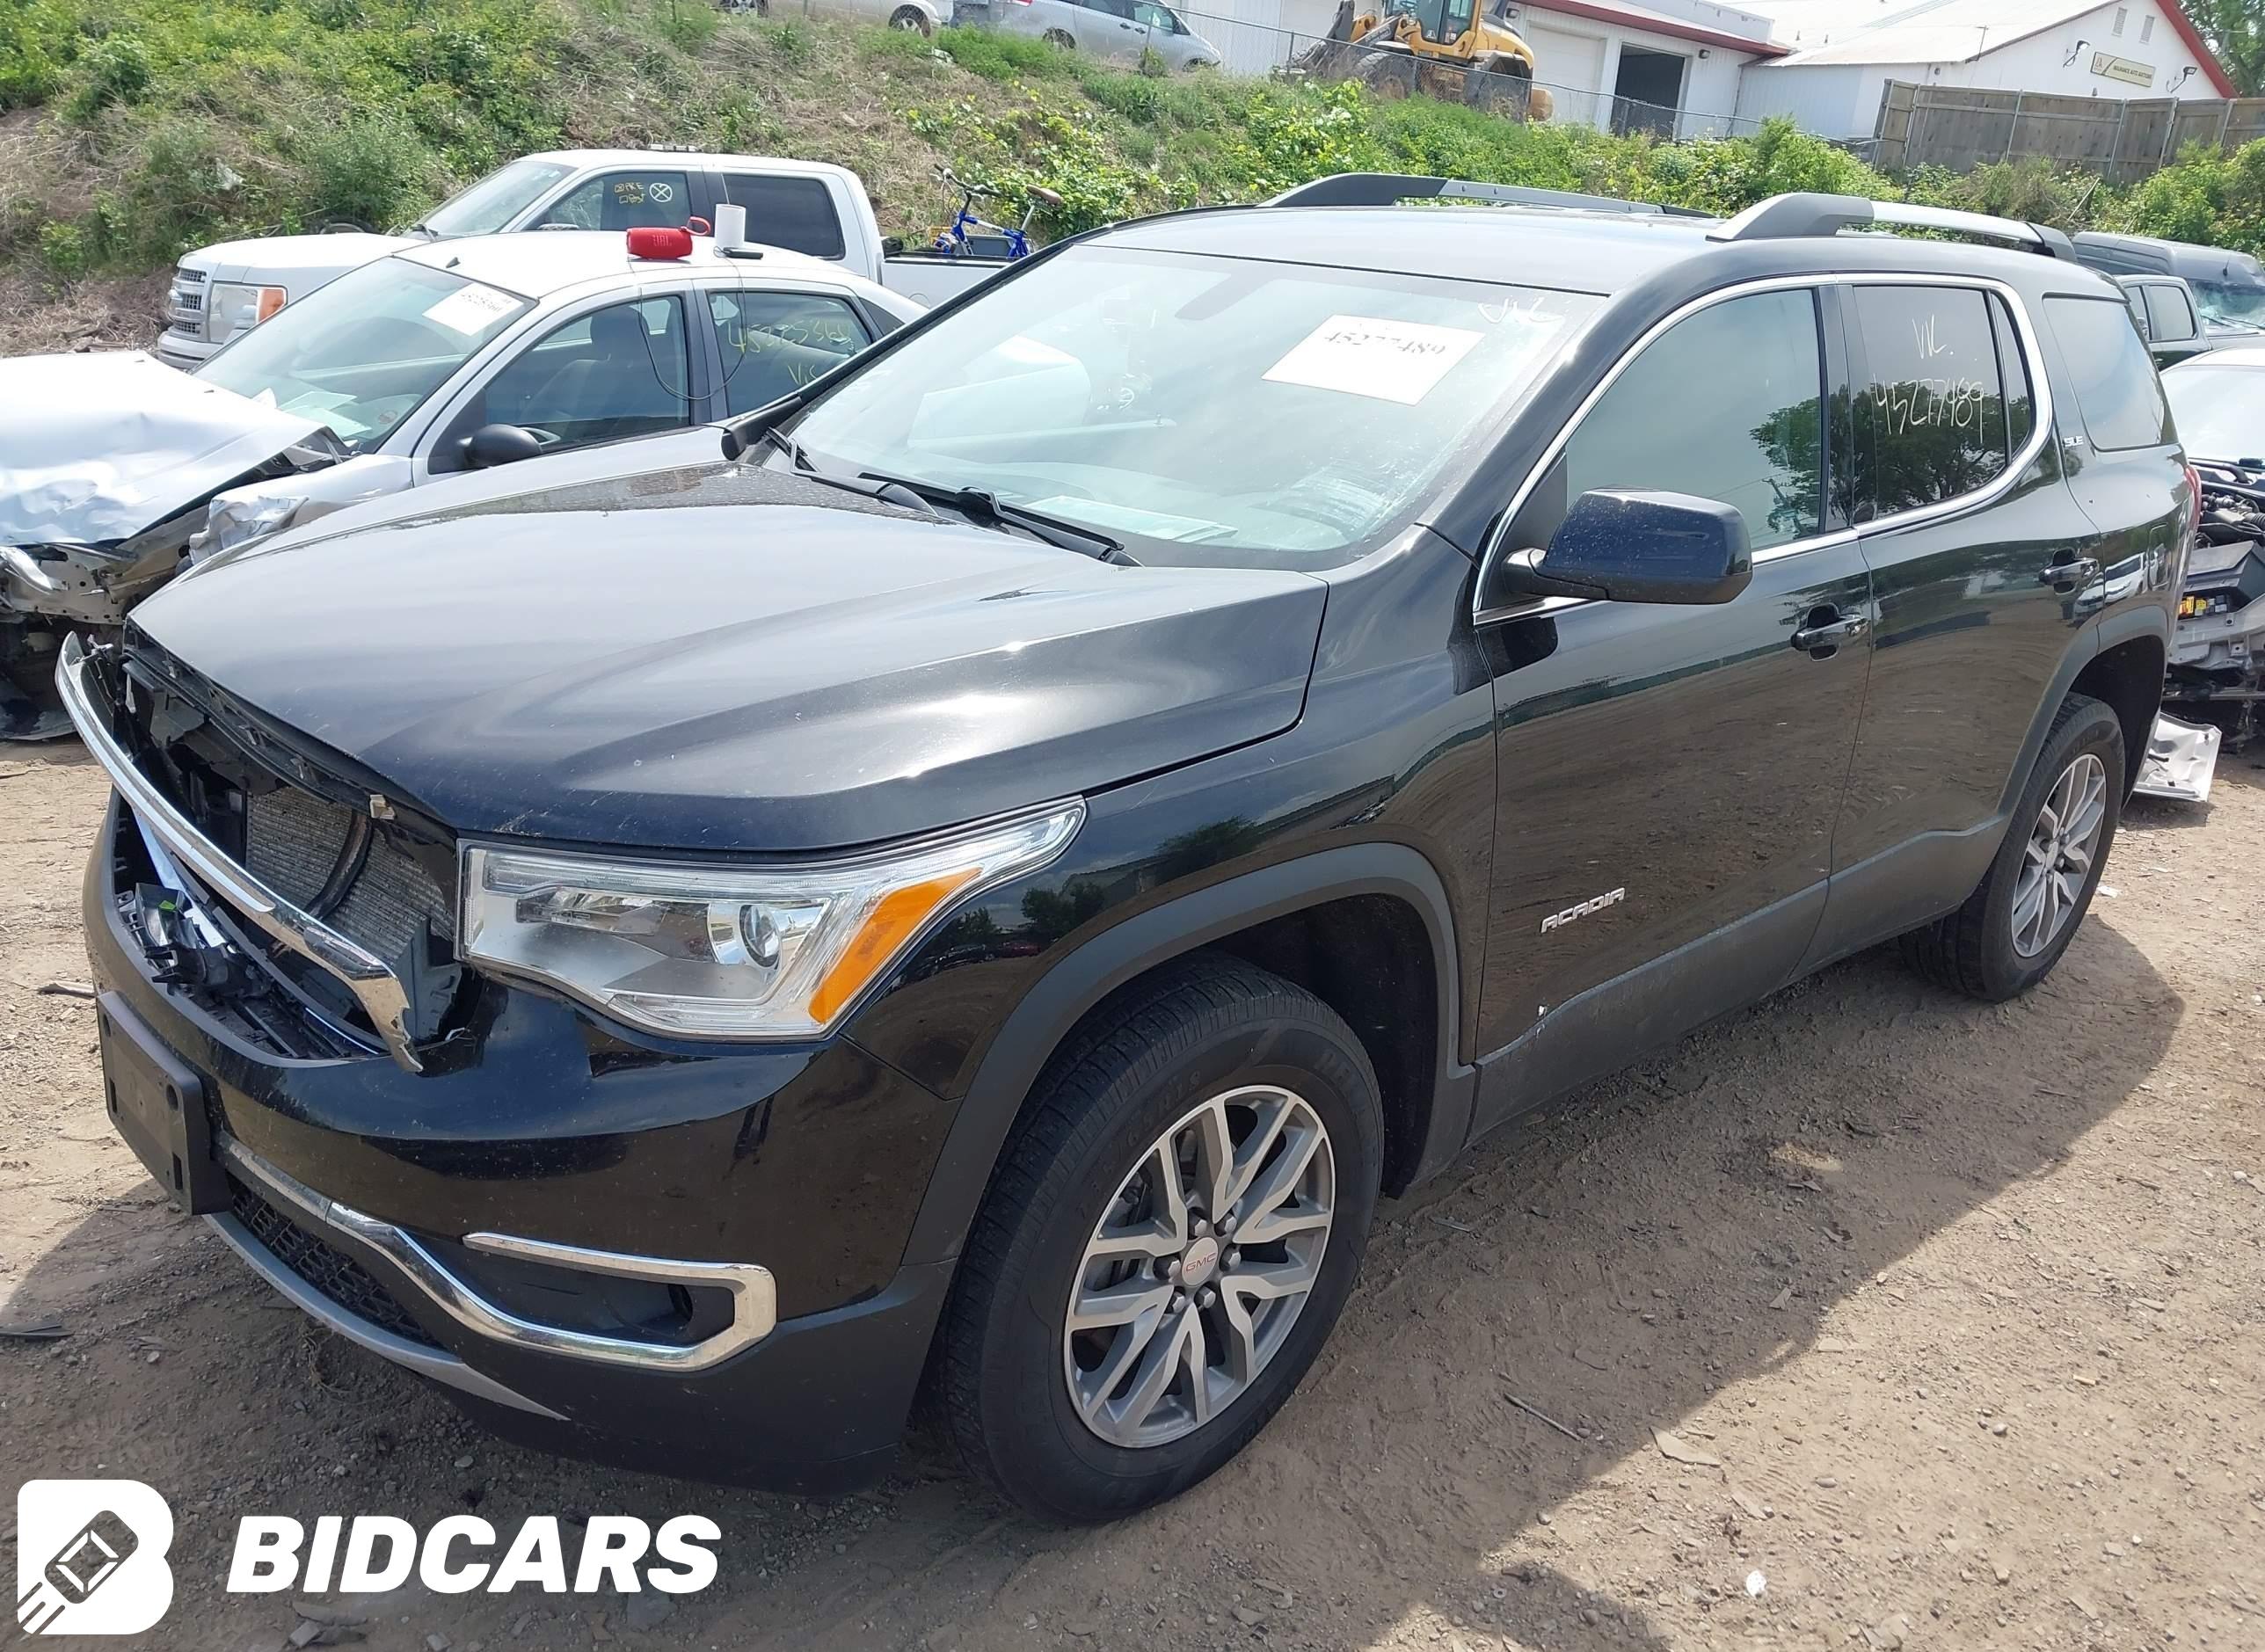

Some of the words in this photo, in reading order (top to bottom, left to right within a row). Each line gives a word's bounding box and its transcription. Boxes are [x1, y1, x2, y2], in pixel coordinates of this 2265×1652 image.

[1873, 373, 1985, 443] 45277489
[1540, 887, 1626, 934] ACADIA
[1186, 1252, 1216, 1271] GMC
